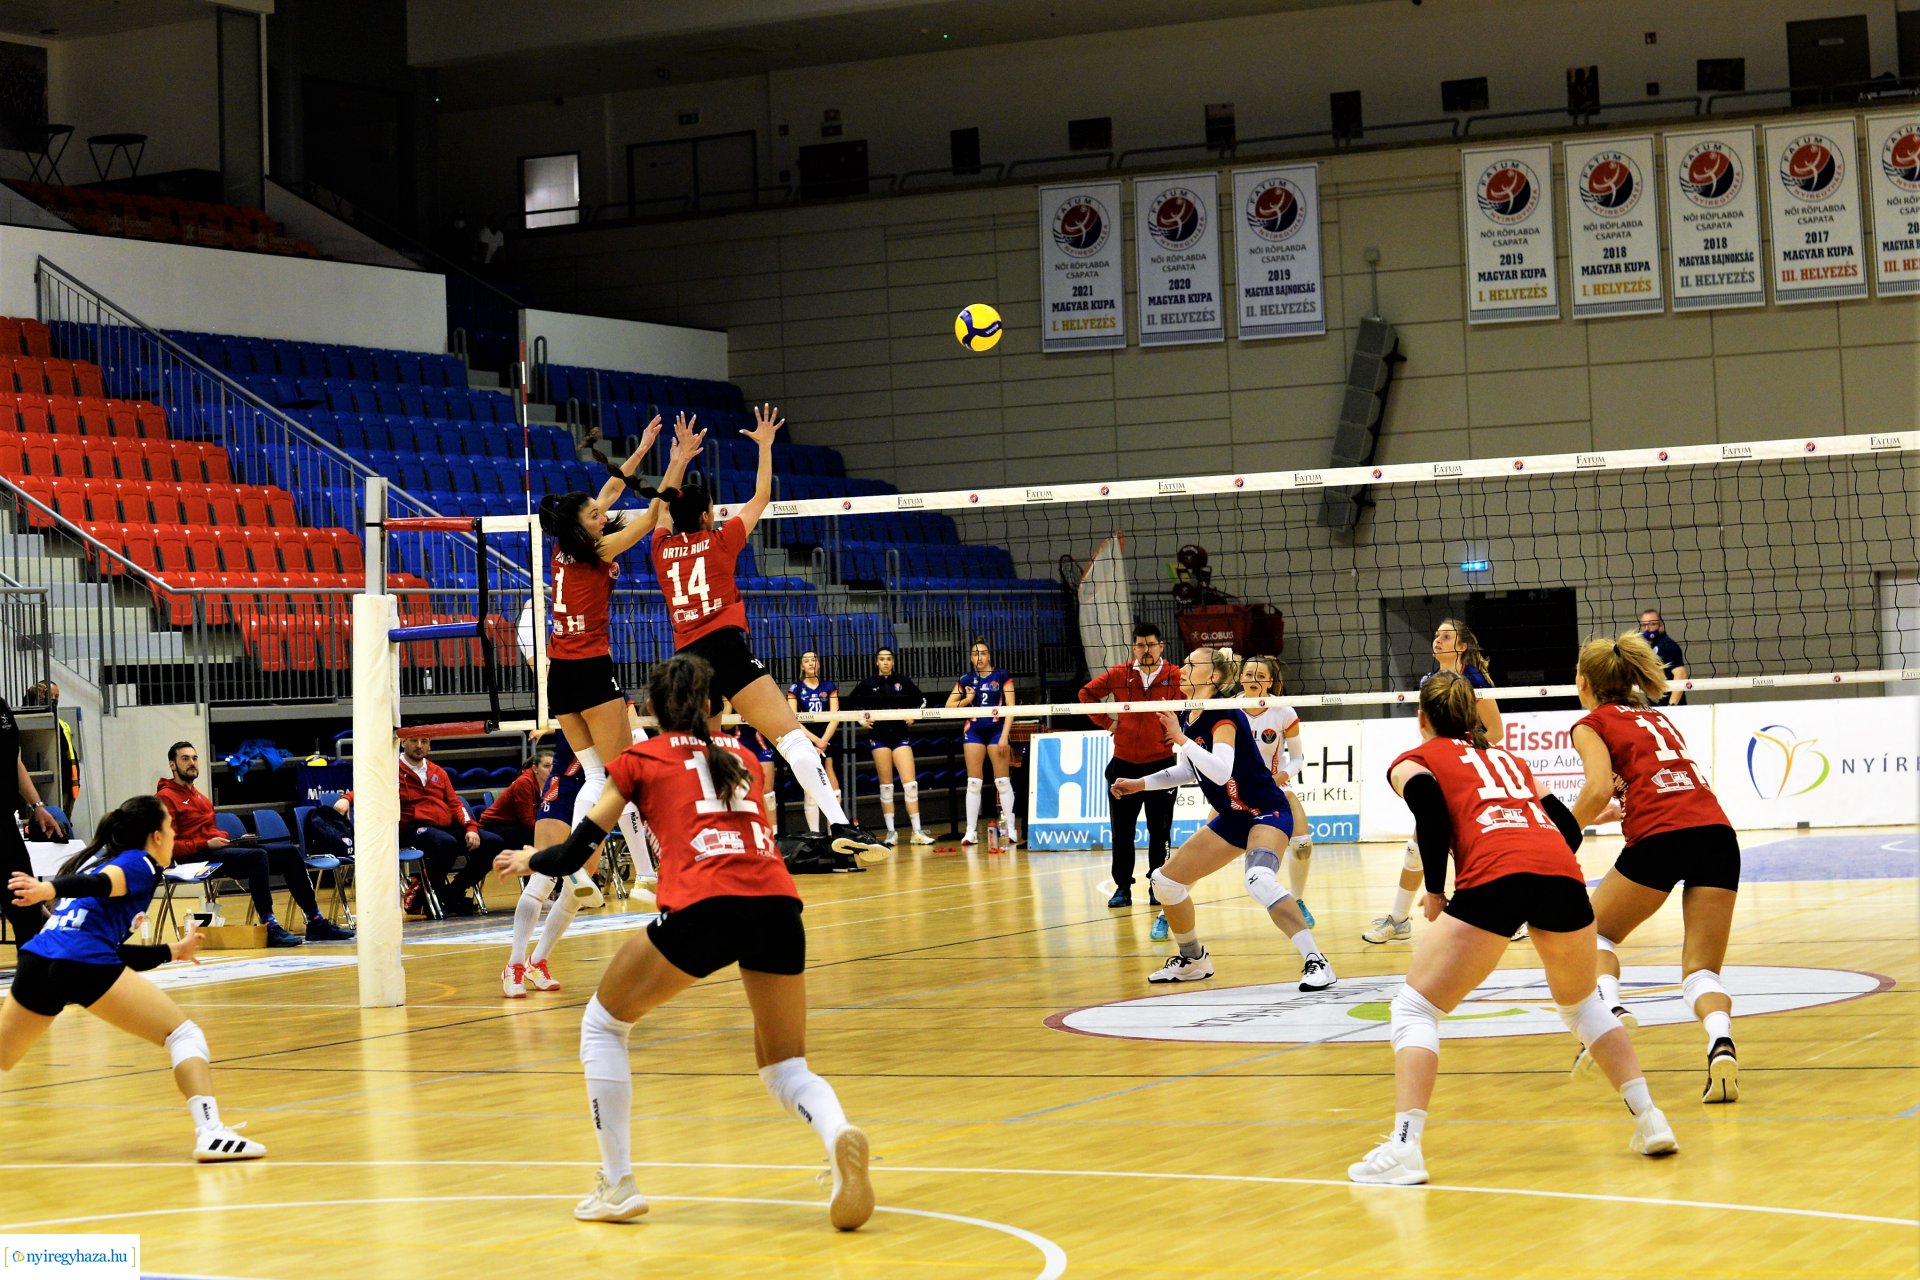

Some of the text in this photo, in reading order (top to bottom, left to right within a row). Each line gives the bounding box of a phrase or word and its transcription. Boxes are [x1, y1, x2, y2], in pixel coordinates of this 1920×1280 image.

[1684, 144, 1722, 168] FATUM
[1784, 137, 1823, 161] FATUM
[1584, 154, 1621, 178] FATUM
[1482, 162, 1520, 187] FATUM
[1250, 179, 1287, 204] FATUM
[1056, 195, 1092, 221] FATUM
[1151, 190, 1187, 214] FATUM
[1696, 221, 1732, 231] CSAPATA
[1797, 215, 1834, 225] CSAPATA
[1493, 238, 1529, 247] CSAPATA
[1596, 231, 1632, 240] CSAPATA
[1805, 231, 1829, 244] 2017
[1703, 238, 1728, 249] 2018
[1883, 240, 1915, 252] MAGYAR
[1261, 255, 1296, 263] CSAPATA
[1500, 253, 1523, 265] 2019
[1603, 247, 1627, 259] 2018
[1679, 250, 1754, 267] MAGYAR BAJNOKSÁG
[1783, 246, 1854, 261] MAGYAR KUPA
[1162, 264, 1196, 272] CSAPATA
[1581, 261, 1651, 276] MAGYAR KUPA
[1781, 262, 1858, 282] III. HELYEZÉS
[1884, 260, 1900, 273] III.
[1066, 271, 1099, 280] CSAPATA
[1268, 269, 1291, 281] 2019
[1478, 268, 1547, 282] MAGYAR KUPA
[1680, 268, 1755, 288] II. HELYEZÉS
[1072, 285, 1094, 297] 2021
[1169, 278, 1191, 290] 2020
[1245, 280, 1315, 298] MAGYAR BAJNOKSÁG
[1583, 277, 1652, 296] I. HELYEZÉS
[1148, 292, 1213, 306] MAGYAR KUPA
[1479, 283, 1548, 302] I. HELYEZÉS
[1052, 299, 1115, 312] MAGYAR KUPA
[1246, 299, 1316, 317] II. HELYEZÉS
[1147, 308, 1216, 326] II. HELYEZÉS
[1053, 317, 1116, 332] I. HELYEZÉS
[662, 539, 710, 560] ORTIZ RUIZ
[667, 556, 710, 606] 14
[1201, 631, 1234, 640] GLOBUS
[981, 693, 988, 705] 2
[809, 702, 822, 712] 20
[1635, 715, 1690, 761] 11
[1459, 748, 1534, 799] 10
[1324, 788, 1353, 801] Kft.
